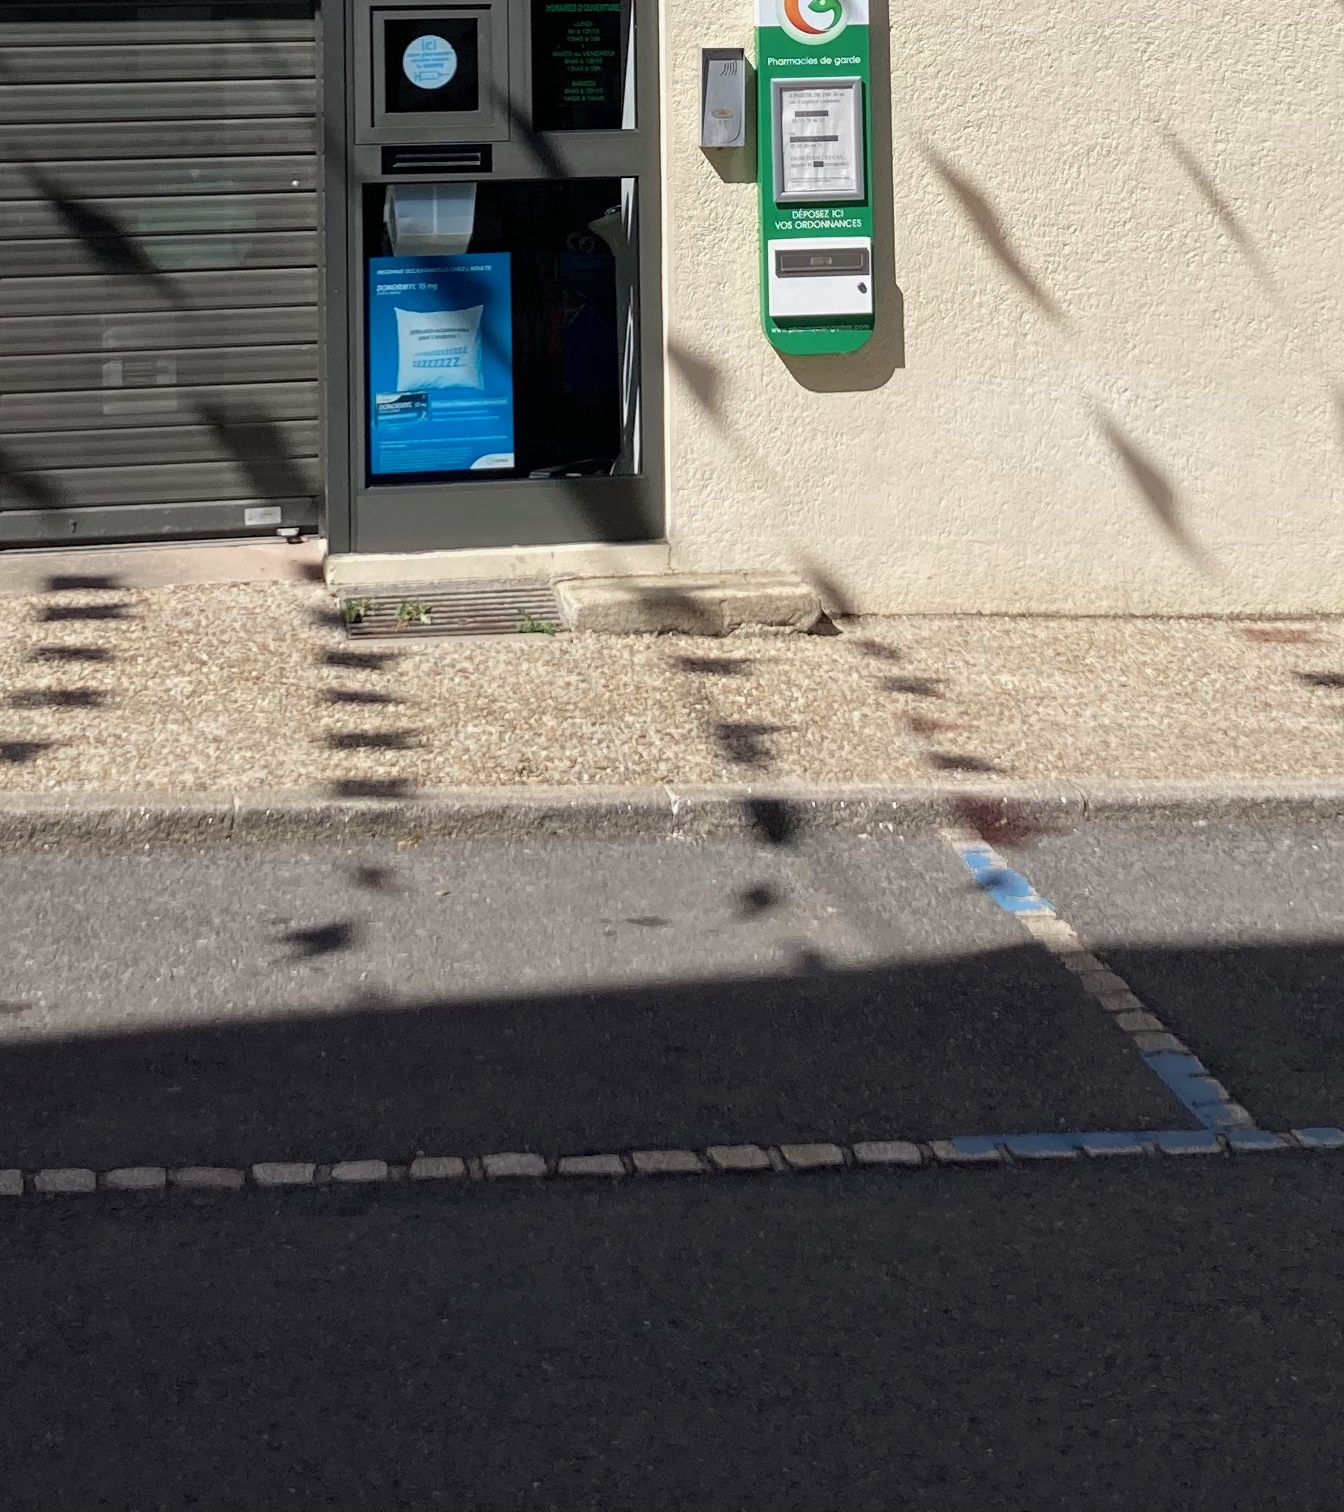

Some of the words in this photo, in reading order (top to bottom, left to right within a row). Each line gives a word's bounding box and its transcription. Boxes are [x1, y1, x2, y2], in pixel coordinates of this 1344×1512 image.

[421, 39, 437, 51] ici
[767, 56, 818, 66] Pharmacies
[819, 56, 833, 65] de
[833, 55, 861, 66] garde
[791, 207, 829, 219] DÉPOSEZ
[831, 208, 844, 218] ICI
[774, 221, 792, 230] VOS
[794, 218, 862, 229] ORDONNANCES
